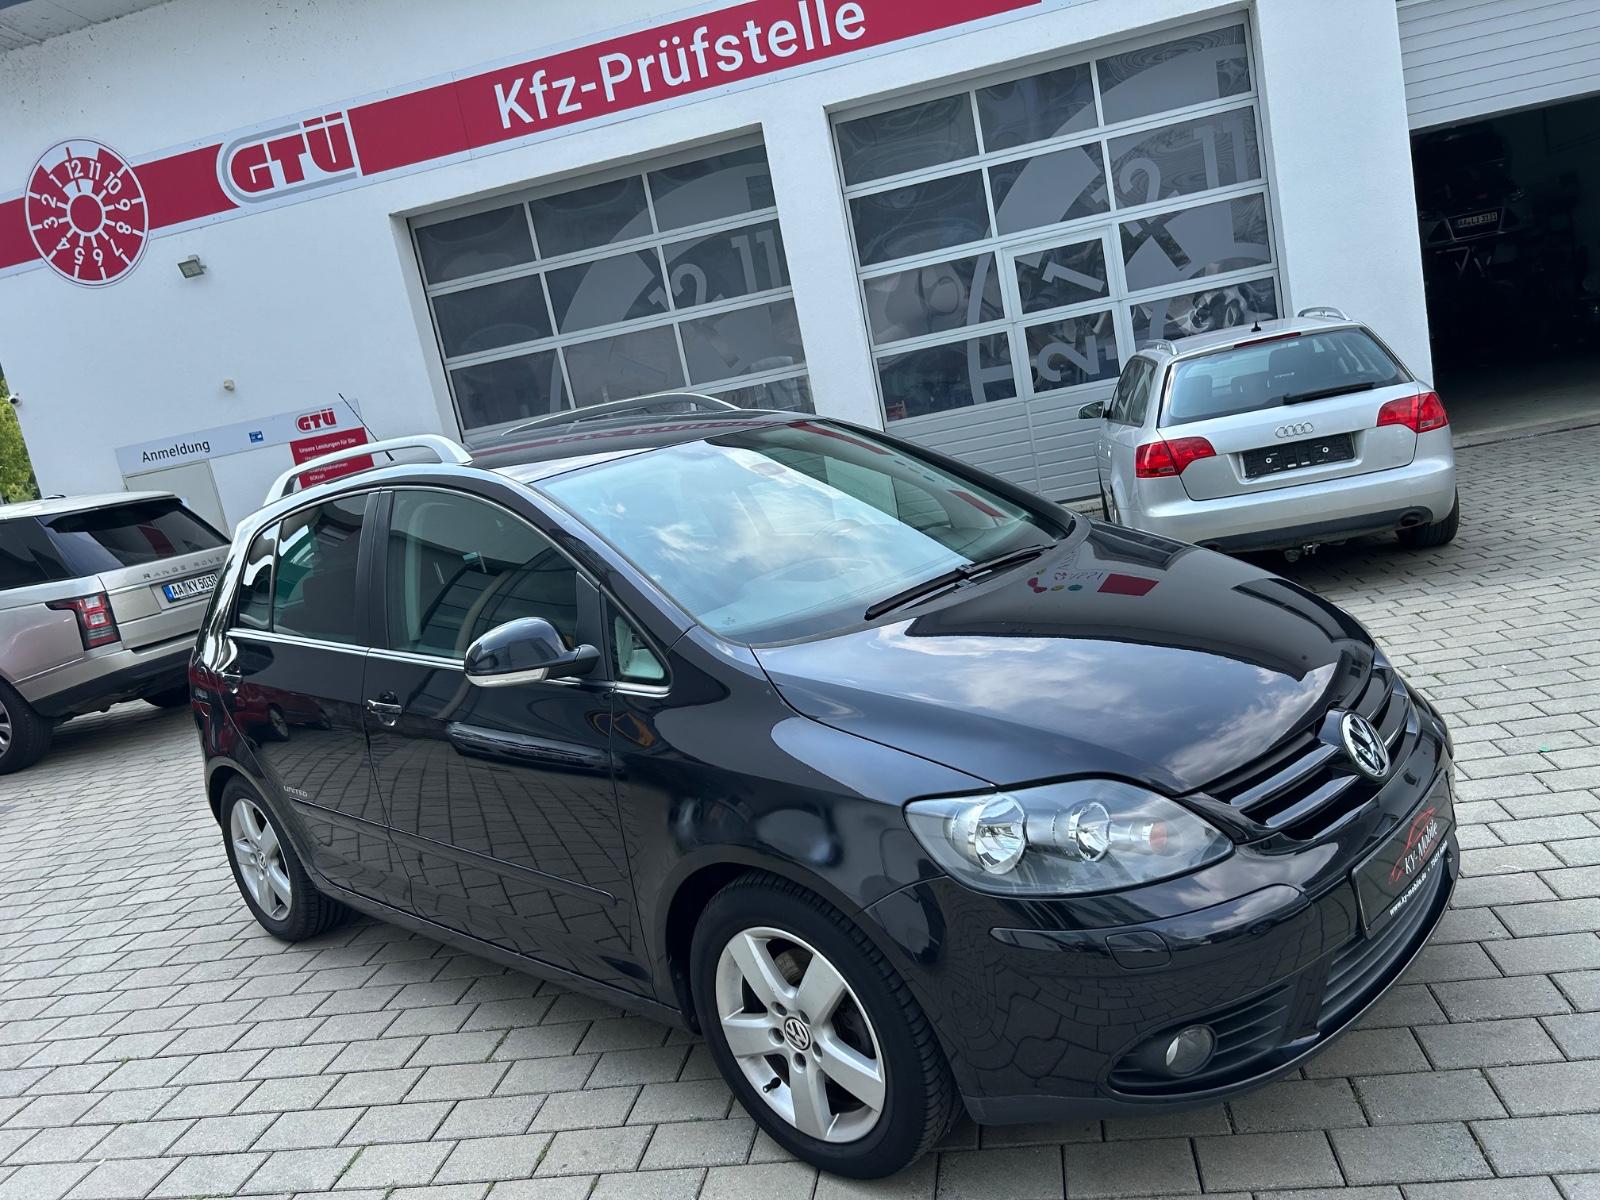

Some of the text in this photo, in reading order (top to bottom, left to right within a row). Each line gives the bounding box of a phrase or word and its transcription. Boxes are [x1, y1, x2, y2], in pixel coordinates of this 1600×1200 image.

[493, 0, 867, 130] Kfz-Prüfstelle
[229, 111, 356, 193] GTÜ
[65, 160, 84, 179] 12
[88, 160, 102, 179] 11
[49, 173, 62, 188] 1
[103, 171, 122, 195] 10
[41, 193, 58, 208] 2
[115, 198, 131, 212] 9
[43, 215, 59, 230] 3
[115, 220, 132, 235] 8
[56, 237, 71, 251] 4
[111, 238, 123, 257] 7
[73, 247, 85, 267] 5
[92, 248, 104, 266] 6
[297, 407, 337, 431] GTÜ
[141, 439, 211, 464] Anmeldung
[143, 565, 187, 579] RANGE
[171, 584, 185, 597] AA
[186, 577, 200, 593] KY
